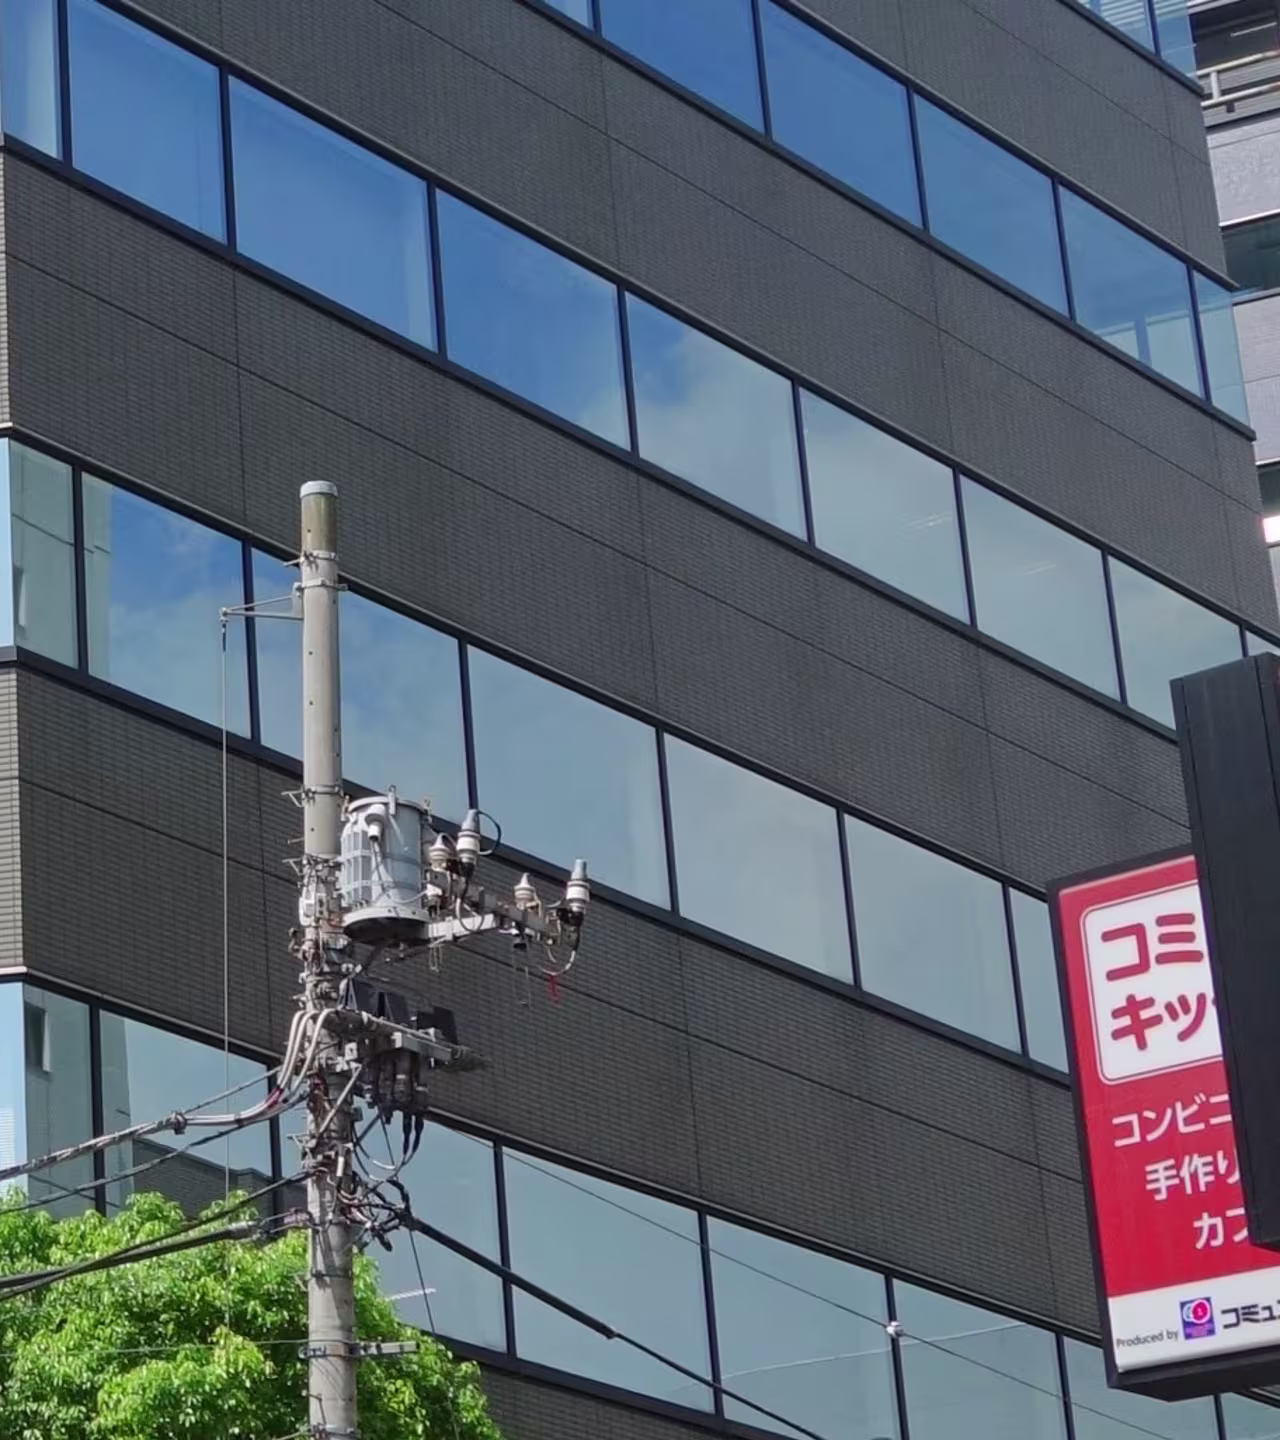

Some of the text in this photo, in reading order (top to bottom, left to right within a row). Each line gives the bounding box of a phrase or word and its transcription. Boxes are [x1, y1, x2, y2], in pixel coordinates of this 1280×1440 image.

[1111, 992, 1214, 1050] キッ
[1145, 1150, 1240, 1200] 手作り
[1221, 1299, 1280, 1329] コミュ
[1116, 1332, 1165, 1349] Produced
[1166, 1329, 1179, 1342] by
